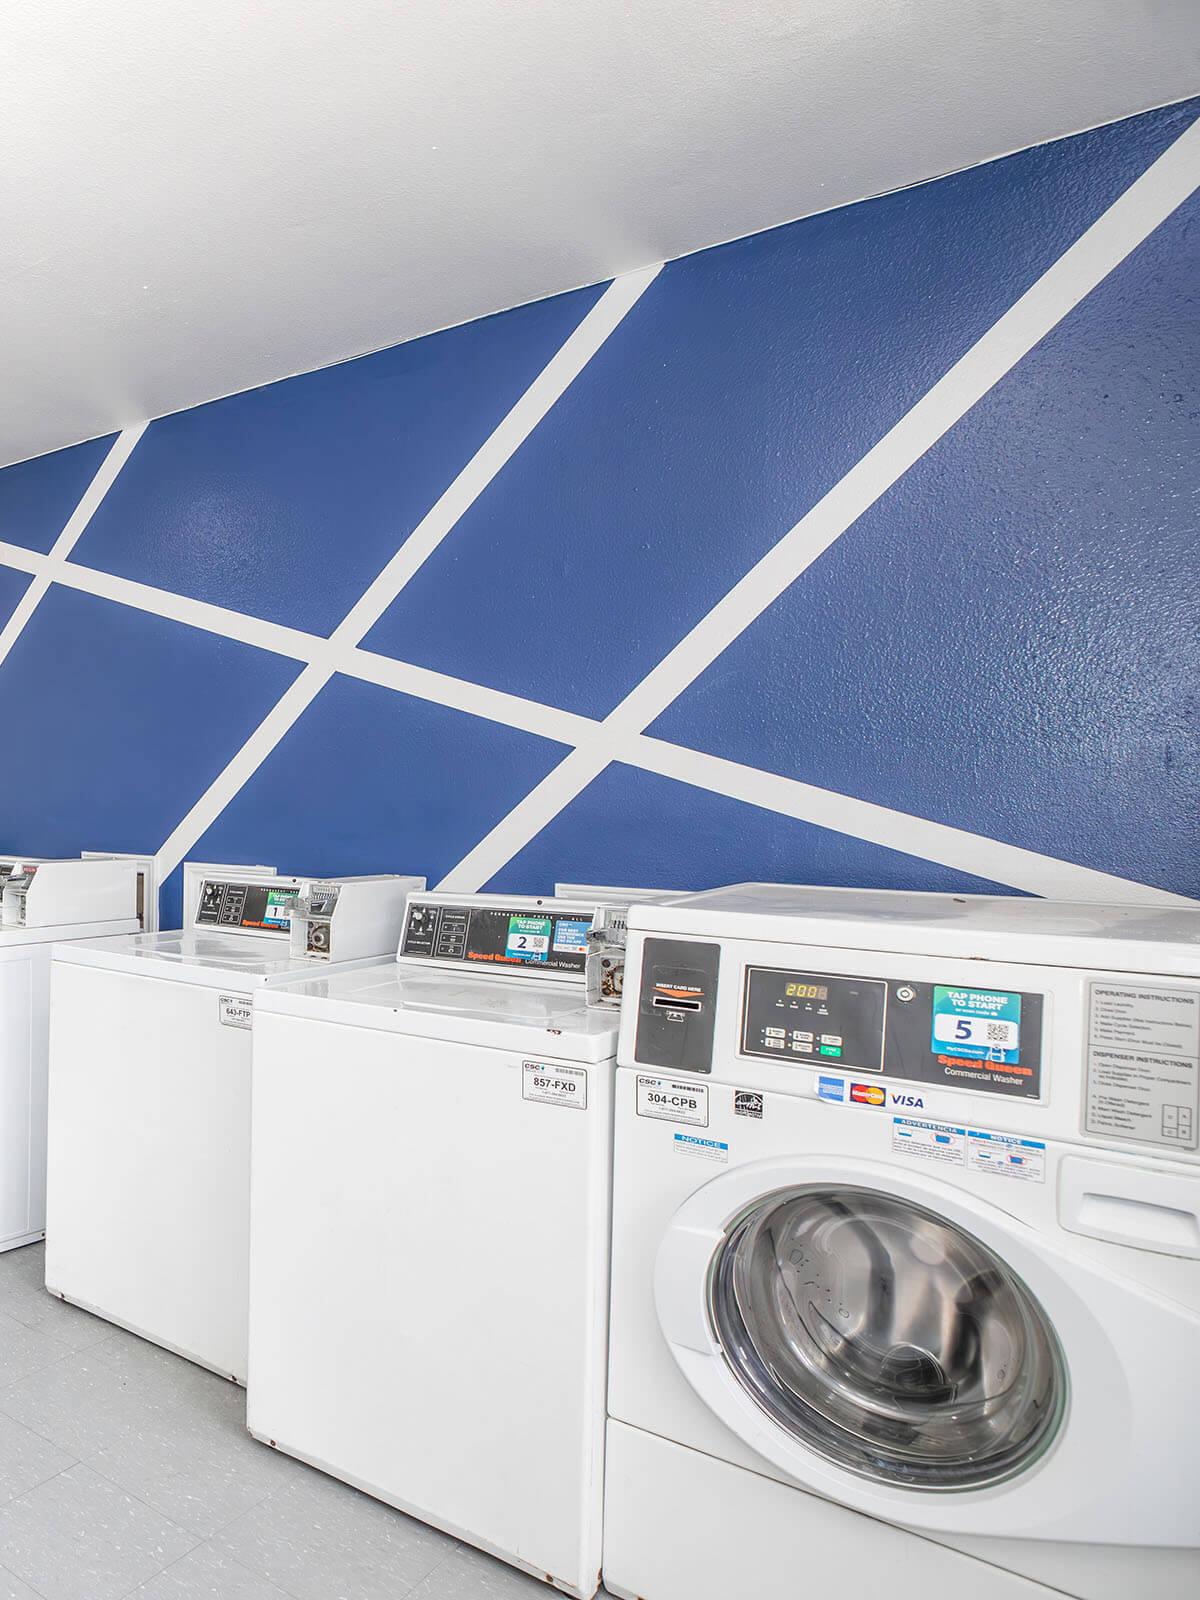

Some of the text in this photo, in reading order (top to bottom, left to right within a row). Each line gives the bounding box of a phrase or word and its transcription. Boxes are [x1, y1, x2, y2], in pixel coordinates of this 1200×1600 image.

[274, 907, 278, 917] 1
[517, 936, 527, 949] 2
[559, 960, 581, 969] Washer
[947, 991, 1009, 1005] TAP PHONE
[1095, 989, 1195, 1005] OPERATING INSTRUCTIONS
[951, 998, 1003, 1011] TO START
[955, 1020, 972, 1040] 5
[937, 1054, 1033, 1076] Speed Queen
[1093, 1050, 1193, 1069] DISPENSER INSTRUCTIONS
[639, 1078, 657, 1086] CSC
[944, 1067, 1024, 1086] Commercial Washer
[533, 1077, 576, 1092] 857-FXD
[647, 1092, 697, 1109] 304-CPB
[891, 1094, 924, 1108] VISA
[900, 1119, 958, 1134] ADVERTENCIA
[681, 1135, 720, 1148] NOTICE
[991, 1135, 1022, 1145] NOTICE
